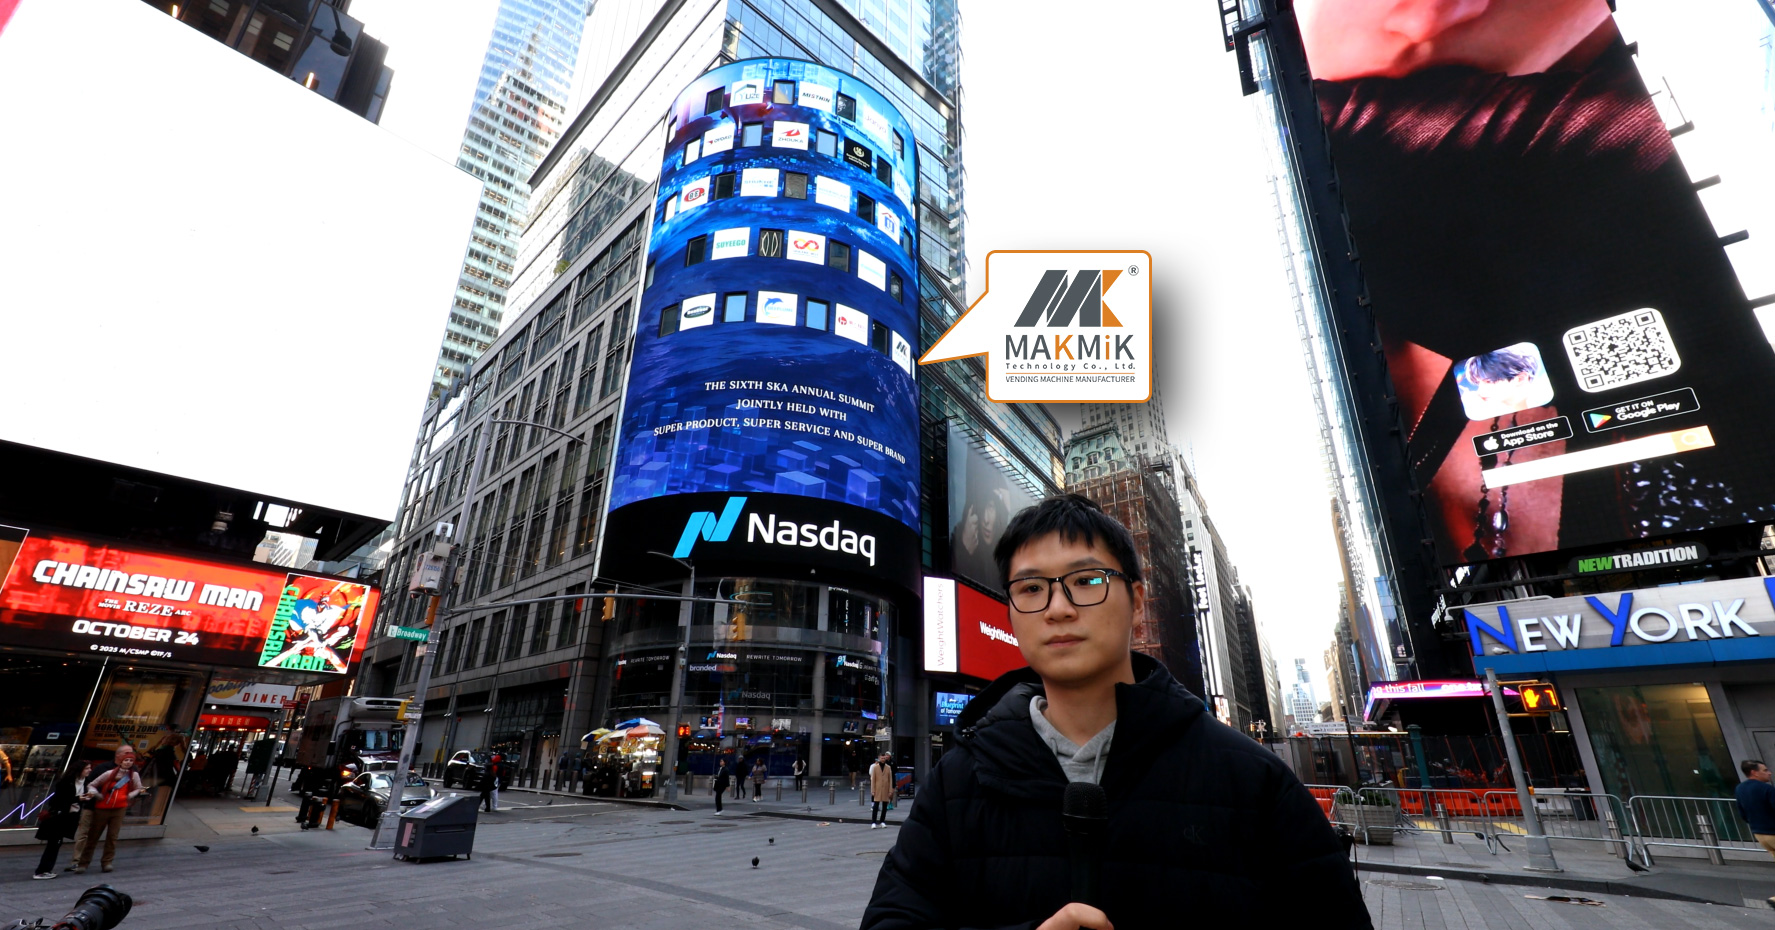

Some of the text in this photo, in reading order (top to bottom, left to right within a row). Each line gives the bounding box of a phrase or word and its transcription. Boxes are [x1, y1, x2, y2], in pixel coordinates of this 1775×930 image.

[716, 239, 746, 249] SUYEEGO
[704, 380, 875, 413] THE SIXTH SKA ANNUAL SUMMIT
[735, 399, 847, 422] JOINTLY HELD WITH
[1615, 400, 1654, 414] GET IT ON
[1617, 401, 1681, 422] Google Play
[1500, 422, 1559, 440] Download on the
[1502, 429, 1555, 448] App Store
[653, 417, 906, 465] SUPER PRODUCT, SUPER SERVICE AND SUPER BRAND
[747, 512, 876, 567] Nasdaq
[32, 559, 264, 611] CHAINSAW MAN
[123, 600, 174, 616] REZE
[937, 583, 946, 666] WeightWatchers
[1585, 592, 1760, 646] YORK
[72, 619, 200, 645] OCTOBER 24
[397, 628, 427, 641] Broadway
[979, 621, 1019, 647] WeightWatche
[99, 645, 118, 653] 2025
[716, 652, 737, 660] Nasdaq
[280, 653, 325, 671] MAN
[689, 664, 717, 672] branded
[741, 691, 771, 699] Nasdaq
[1385, 684, 1405, 693] this
[1408, 683, 1425, 692] fall
[242, 692, 287, 704] DINER
[136, 725, 159, 733] ZORO
[211, 717, 251, 725] DINER
